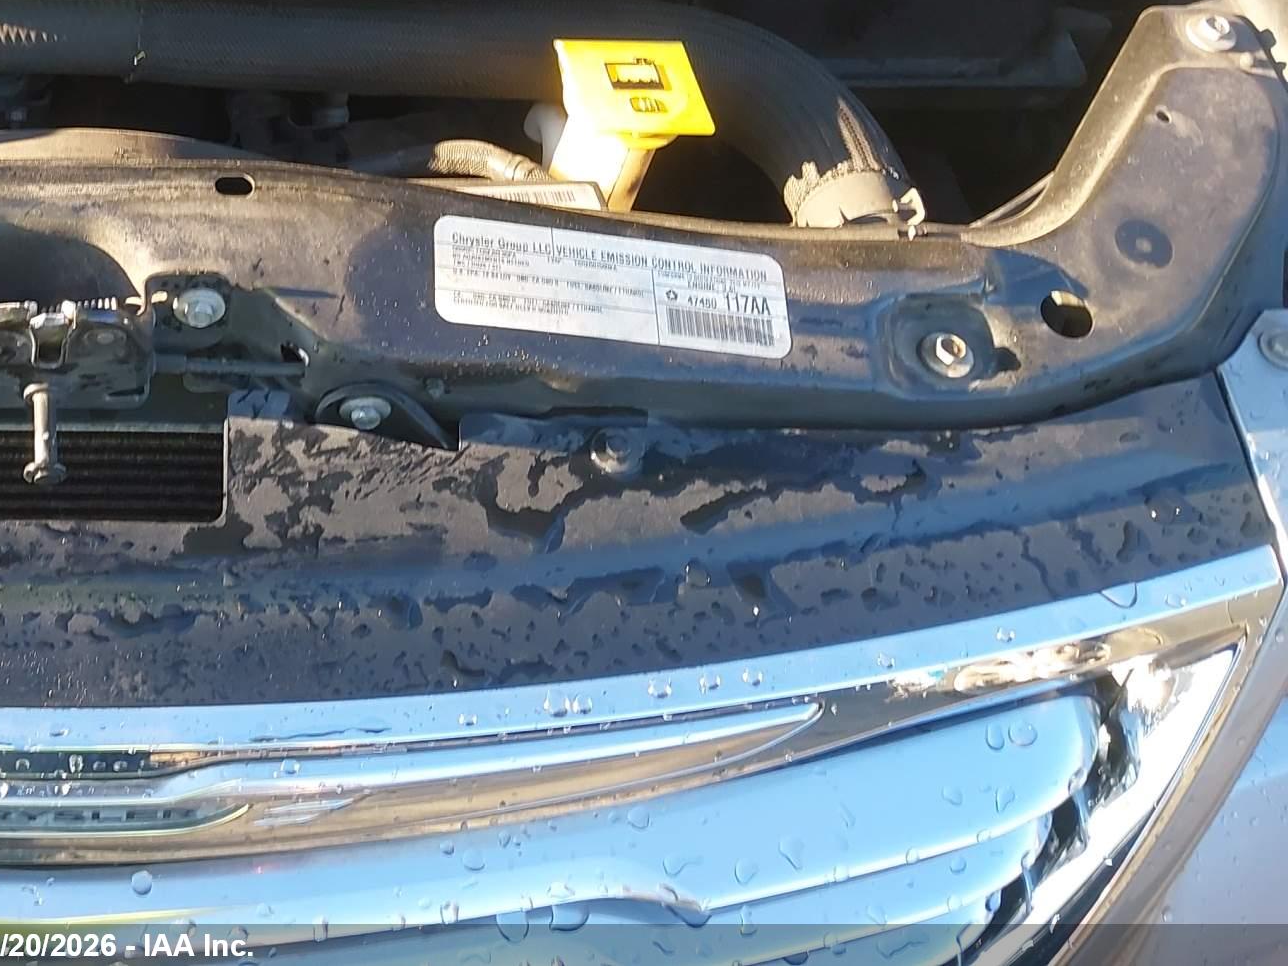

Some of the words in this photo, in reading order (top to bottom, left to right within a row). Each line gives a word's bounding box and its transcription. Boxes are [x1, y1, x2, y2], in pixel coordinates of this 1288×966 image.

[452, 232, 493, 247] Chrysler
[498, 237, 529, 253] Group
[532, 242, 552, 254] LLC
[556, 243, 597, 261] VEHICLE
[600, 250, 647, 269] EMISSION
[652, 256, 696, 275] CONTROL
[699, 262, 768, 282] INFORMATION
